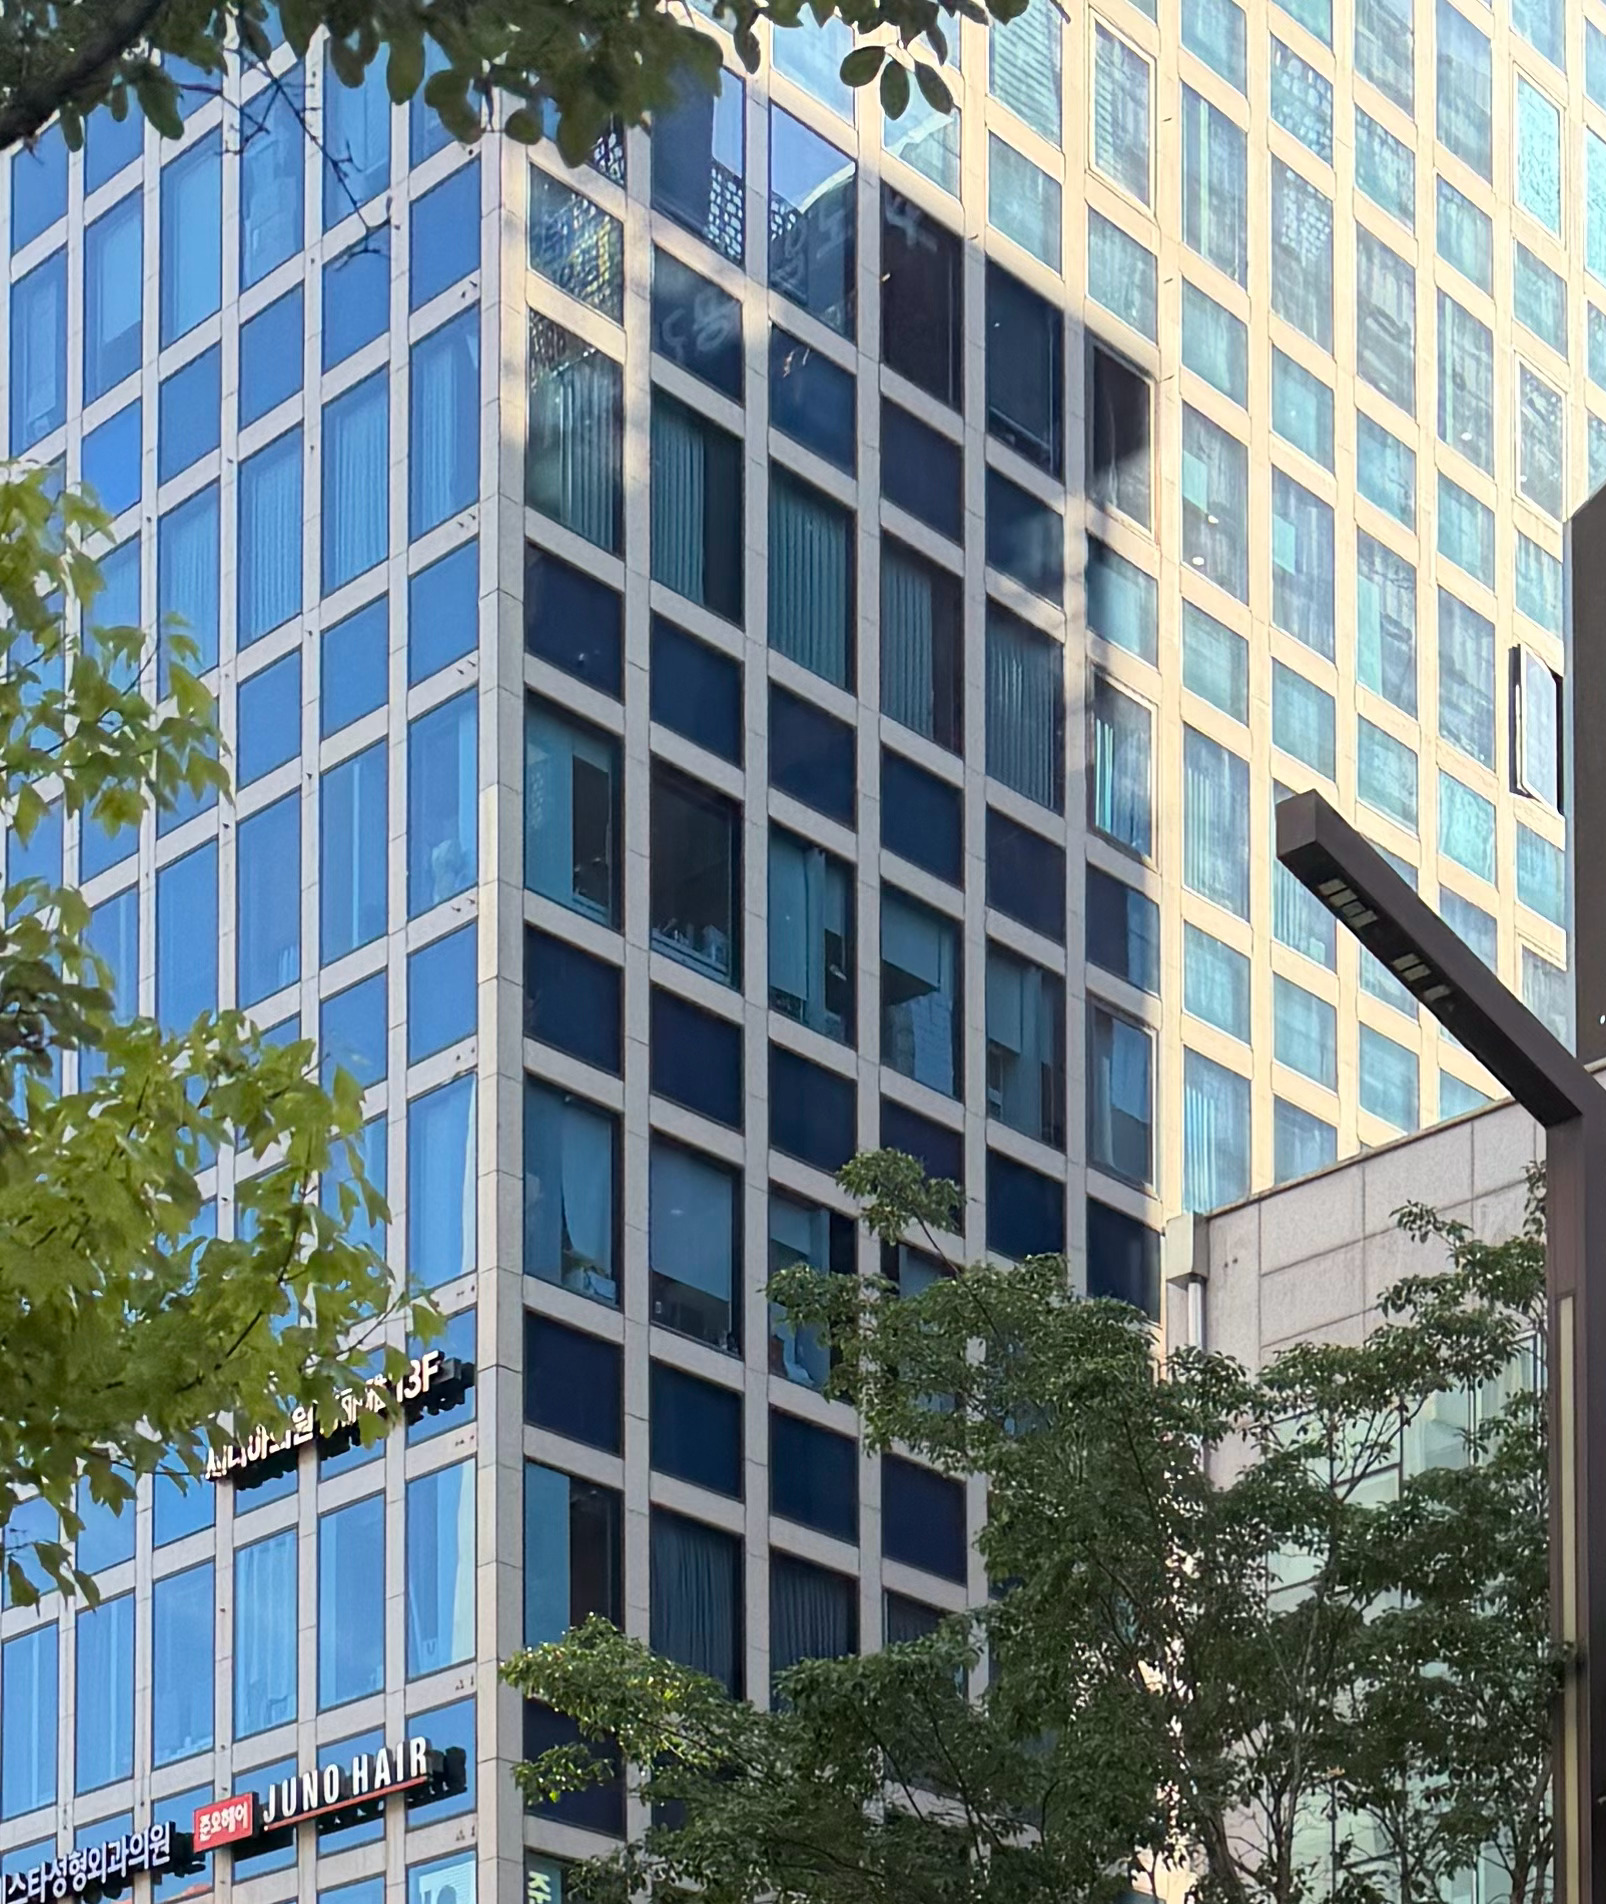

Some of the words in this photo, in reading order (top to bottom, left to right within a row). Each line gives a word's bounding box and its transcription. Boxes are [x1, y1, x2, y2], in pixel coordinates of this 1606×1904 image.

[262, 1763, 340, 1823] JUNO
[352, 1736, 428, 1797] HAIR
[199, 1802, 249, 1841] 준오헤어
